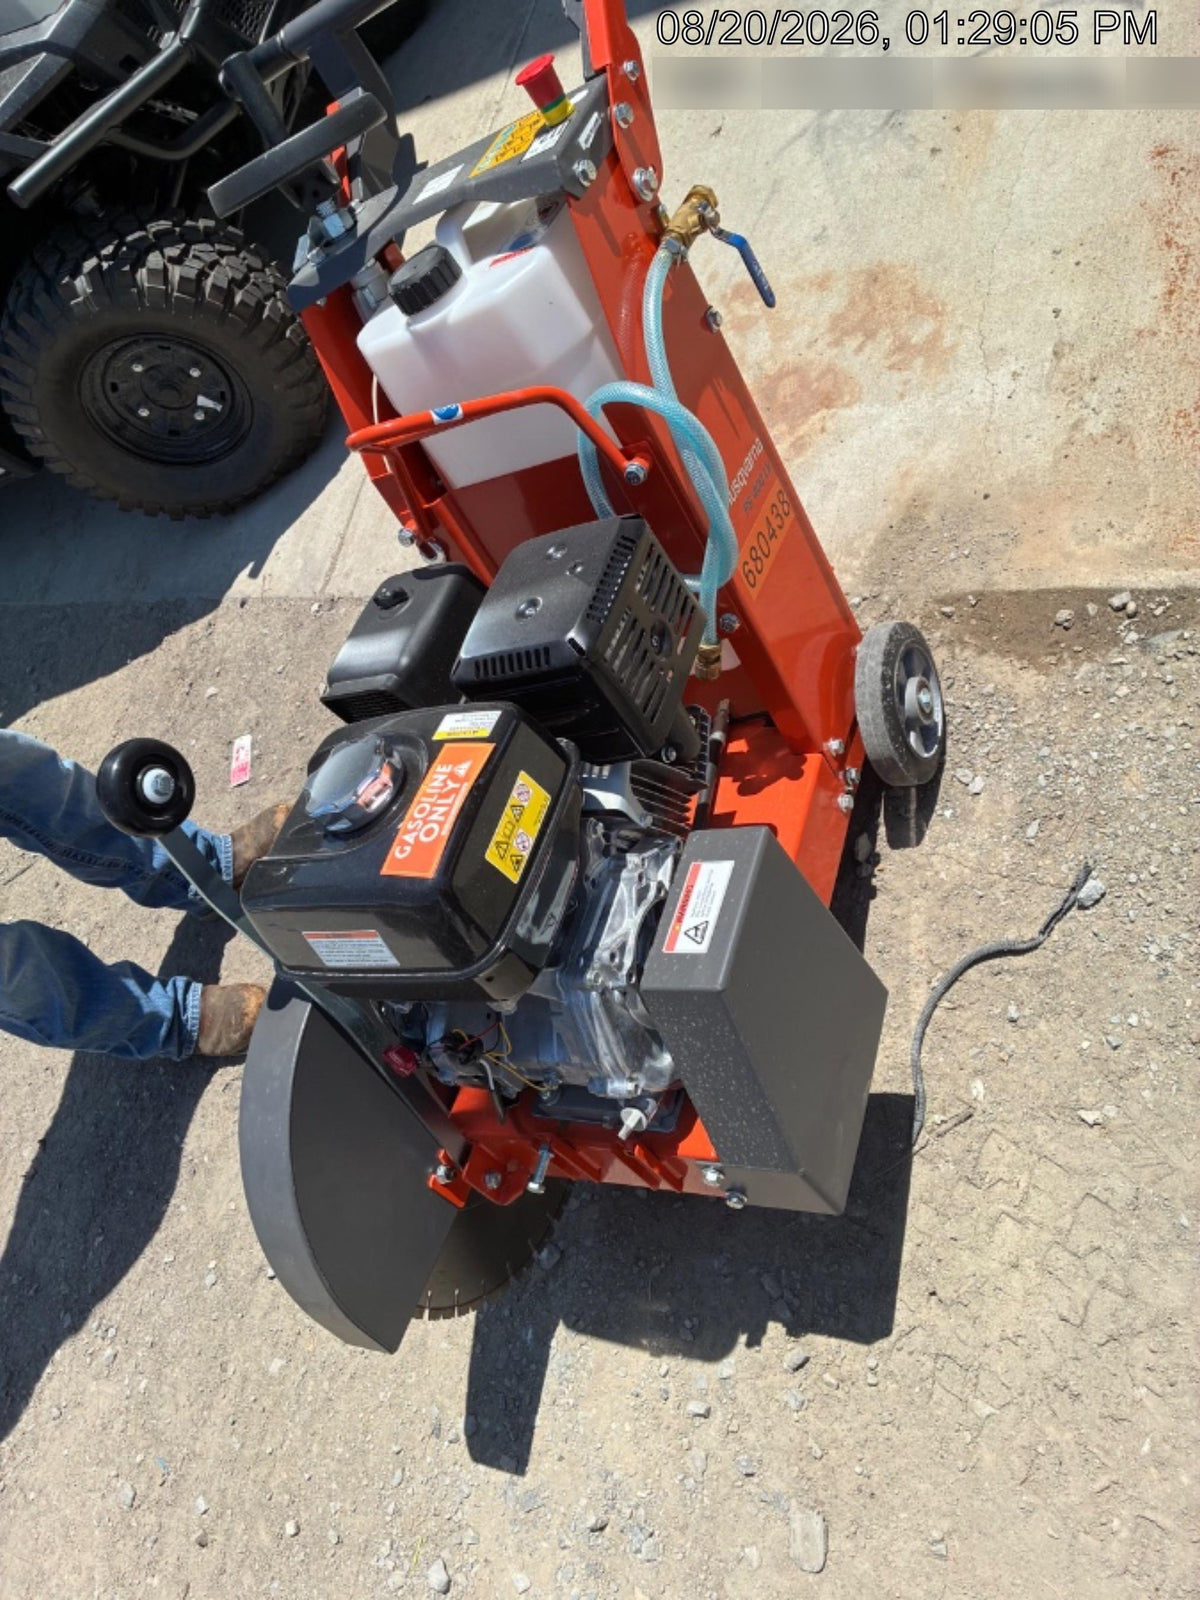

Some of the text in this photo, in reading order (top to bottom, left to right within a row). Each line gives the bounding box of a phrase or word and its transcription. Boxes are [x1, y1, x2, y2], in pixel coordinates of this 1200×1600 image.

[729, 437, 764, 506] usqvarna
[742, 489, 791, 589] 680438
[394, 763, 453, 859] GASOLINE
[418, 777, 461, 843] ONLY
